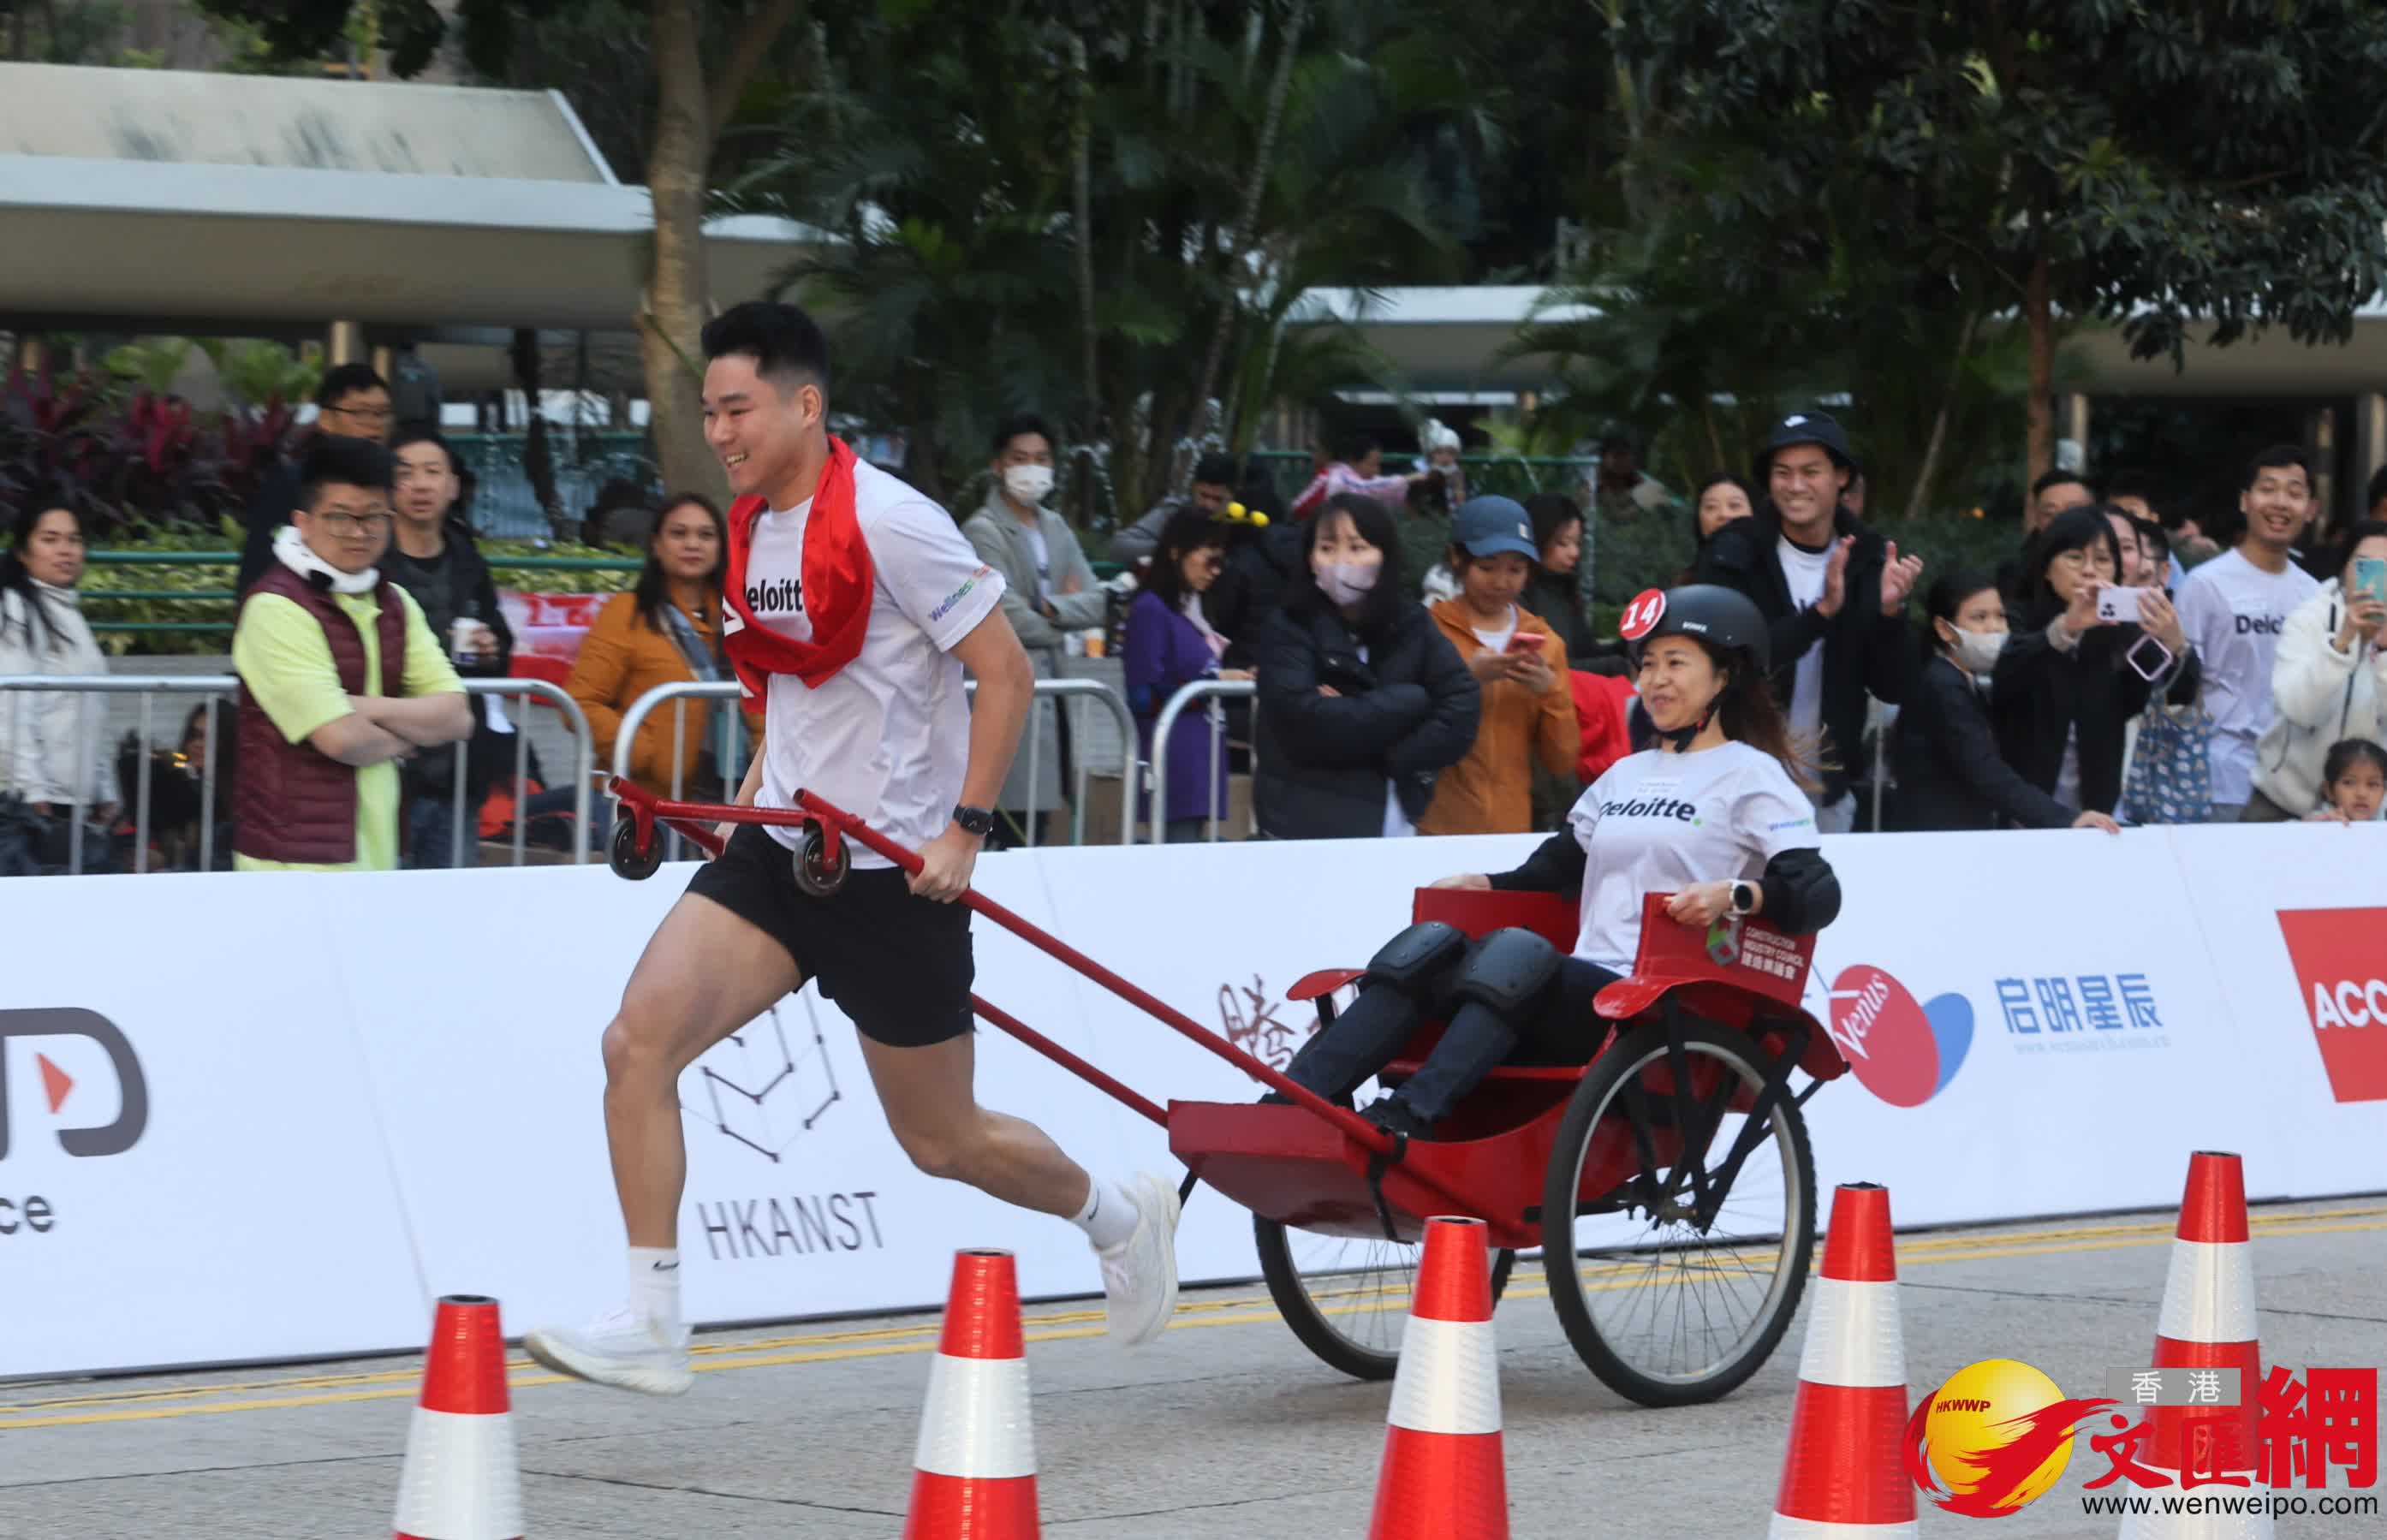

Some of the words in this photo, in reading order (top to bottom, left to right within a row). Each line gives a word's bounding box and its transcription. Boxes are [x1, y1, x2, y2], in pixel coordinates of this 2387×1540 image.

[746, 579, 804, 614] eloitt
[1621, 597, 1659, 632] 14
[2234, 614, 2286, 635] Delo
[1835, 974, 1890, 1060] Venus
[1994, 973, 2164, 1033] 启明星辰
[2314, 978, 2387, 1029] ACC
[695, 1192, 884, 1260] HKANST
